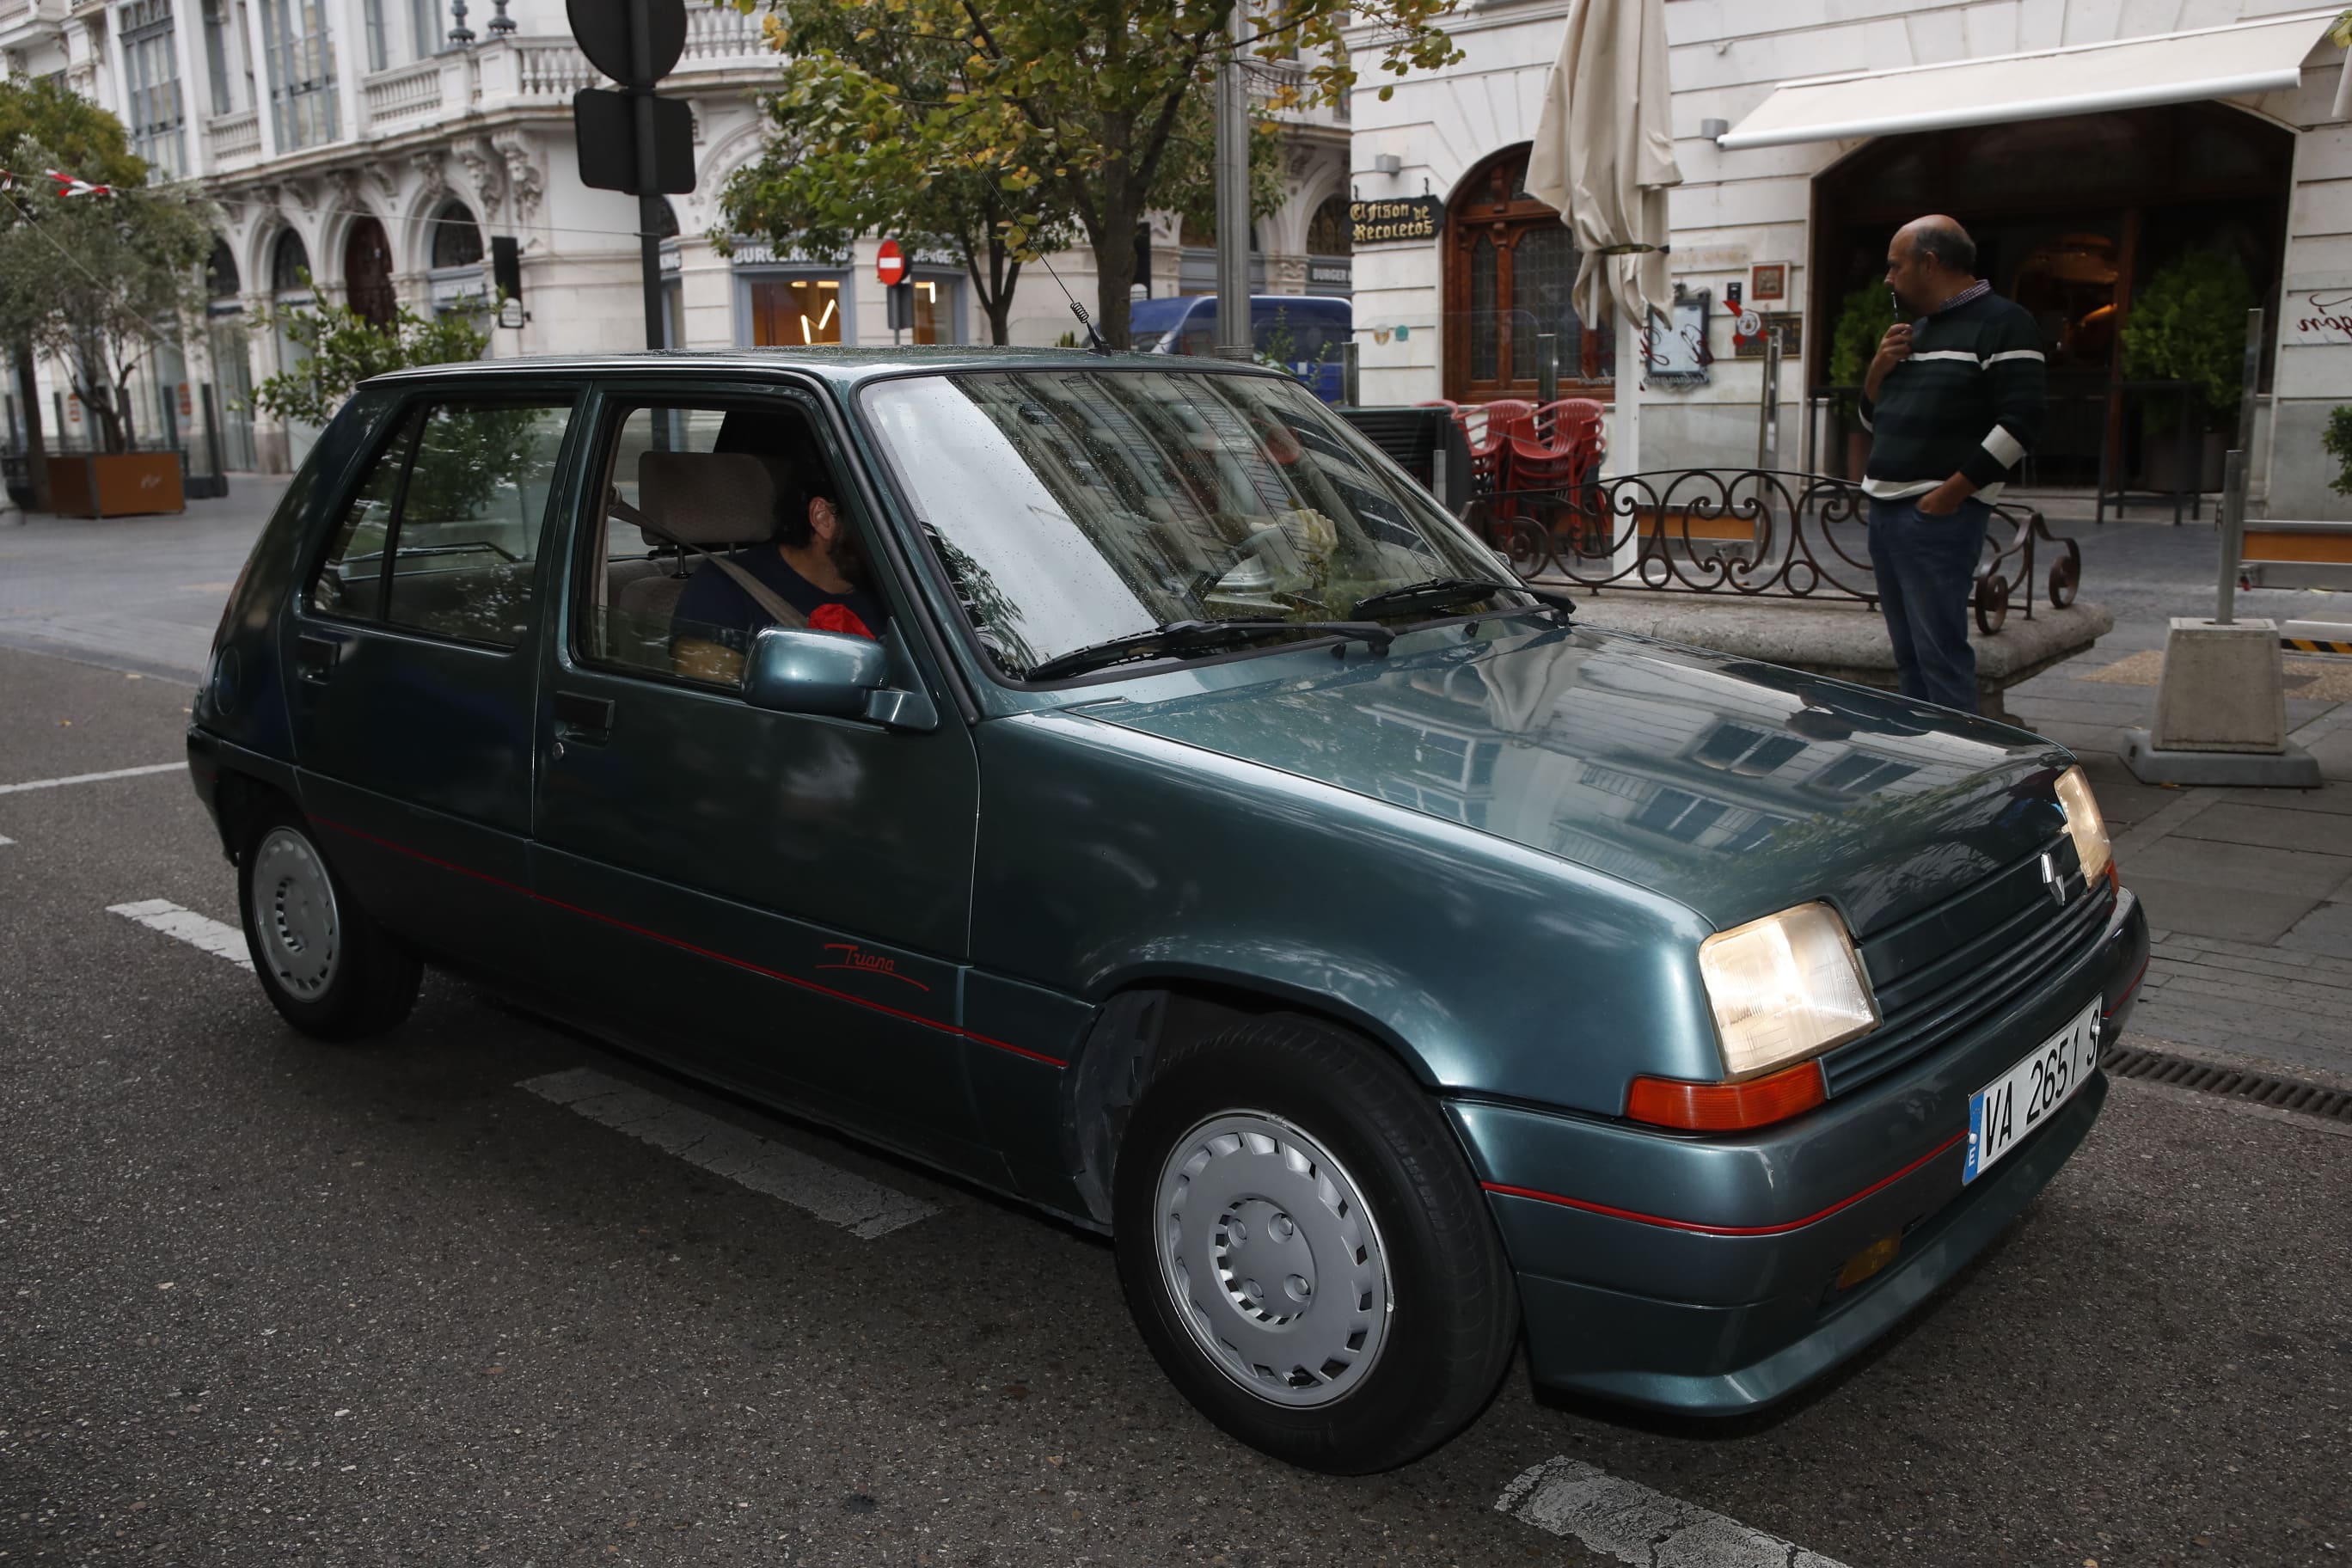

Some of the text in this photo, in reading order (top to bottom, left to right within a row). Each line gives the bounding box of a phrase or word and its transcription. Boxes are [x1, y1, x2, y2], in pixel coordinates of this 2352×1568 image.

[1352, 219, 1435, 242] Recoletos
[1313, 267, 1346, 282] BURGER
[824, 943, 895, 971] Triana
[1986, 1008, 2099, 1158] VA 2651 S
[1968, 1146, 1975, 1167] E
